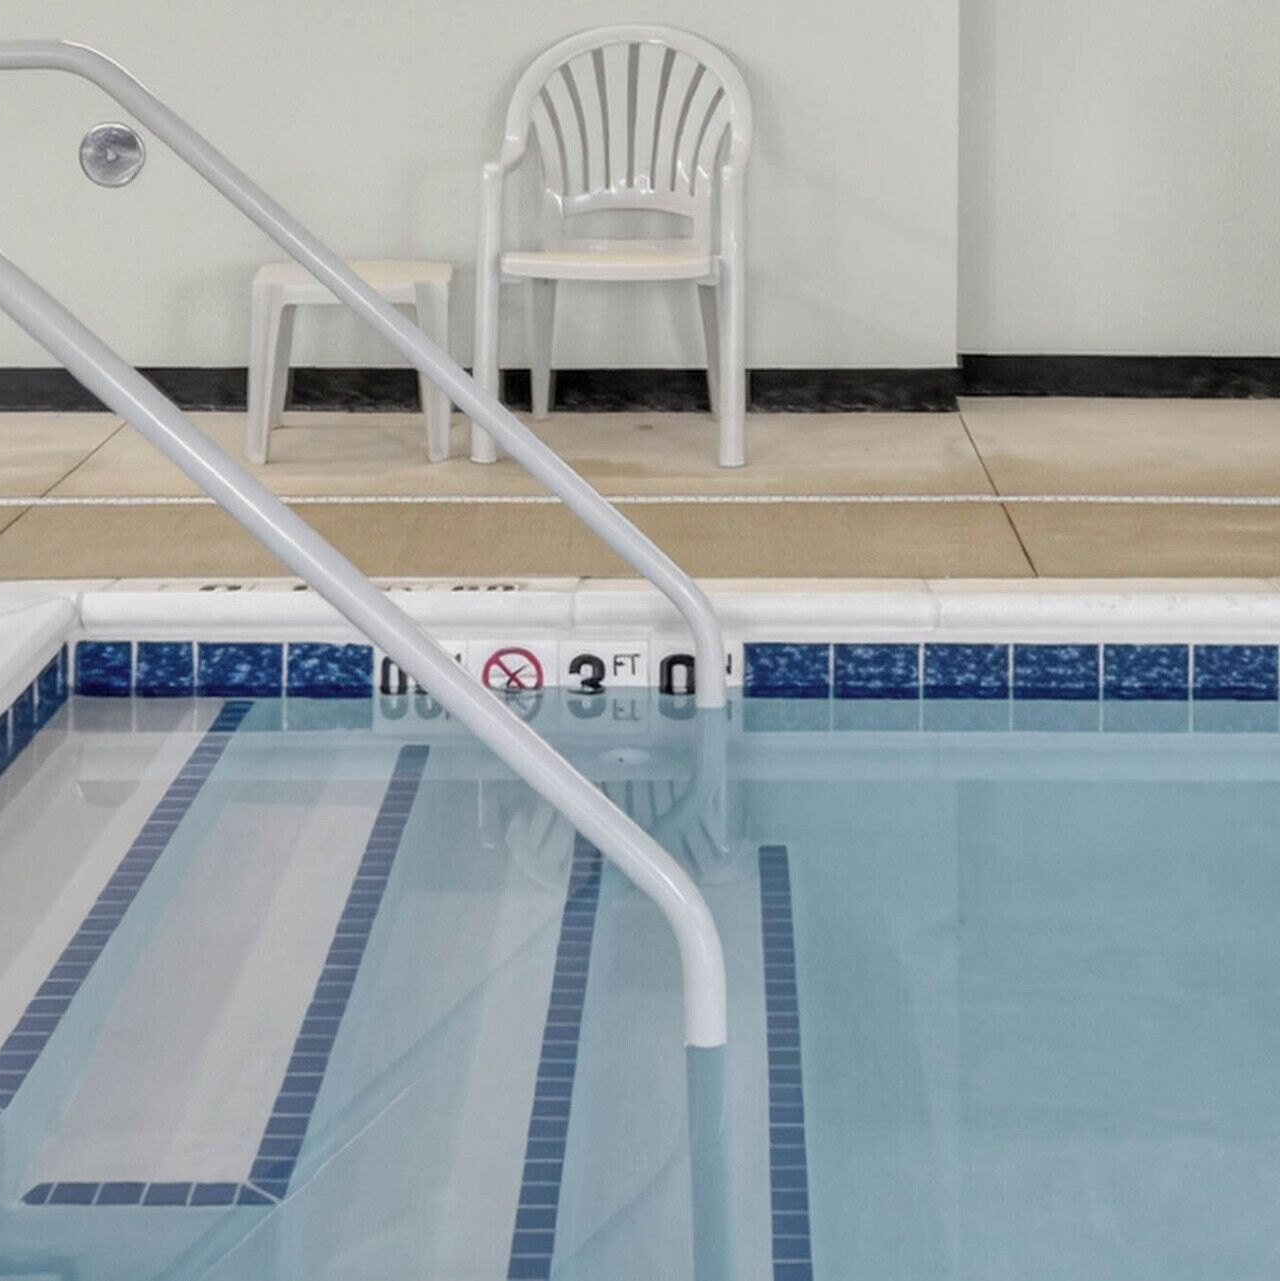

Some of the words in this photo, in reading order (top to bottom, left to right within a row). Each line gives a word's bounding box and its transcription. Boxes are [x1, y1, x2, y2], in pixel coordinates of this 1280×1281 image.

[568, 654, 606, 695] 3
[613, 653, 640, 676] FT
[659, 653, 696, 695] 0
